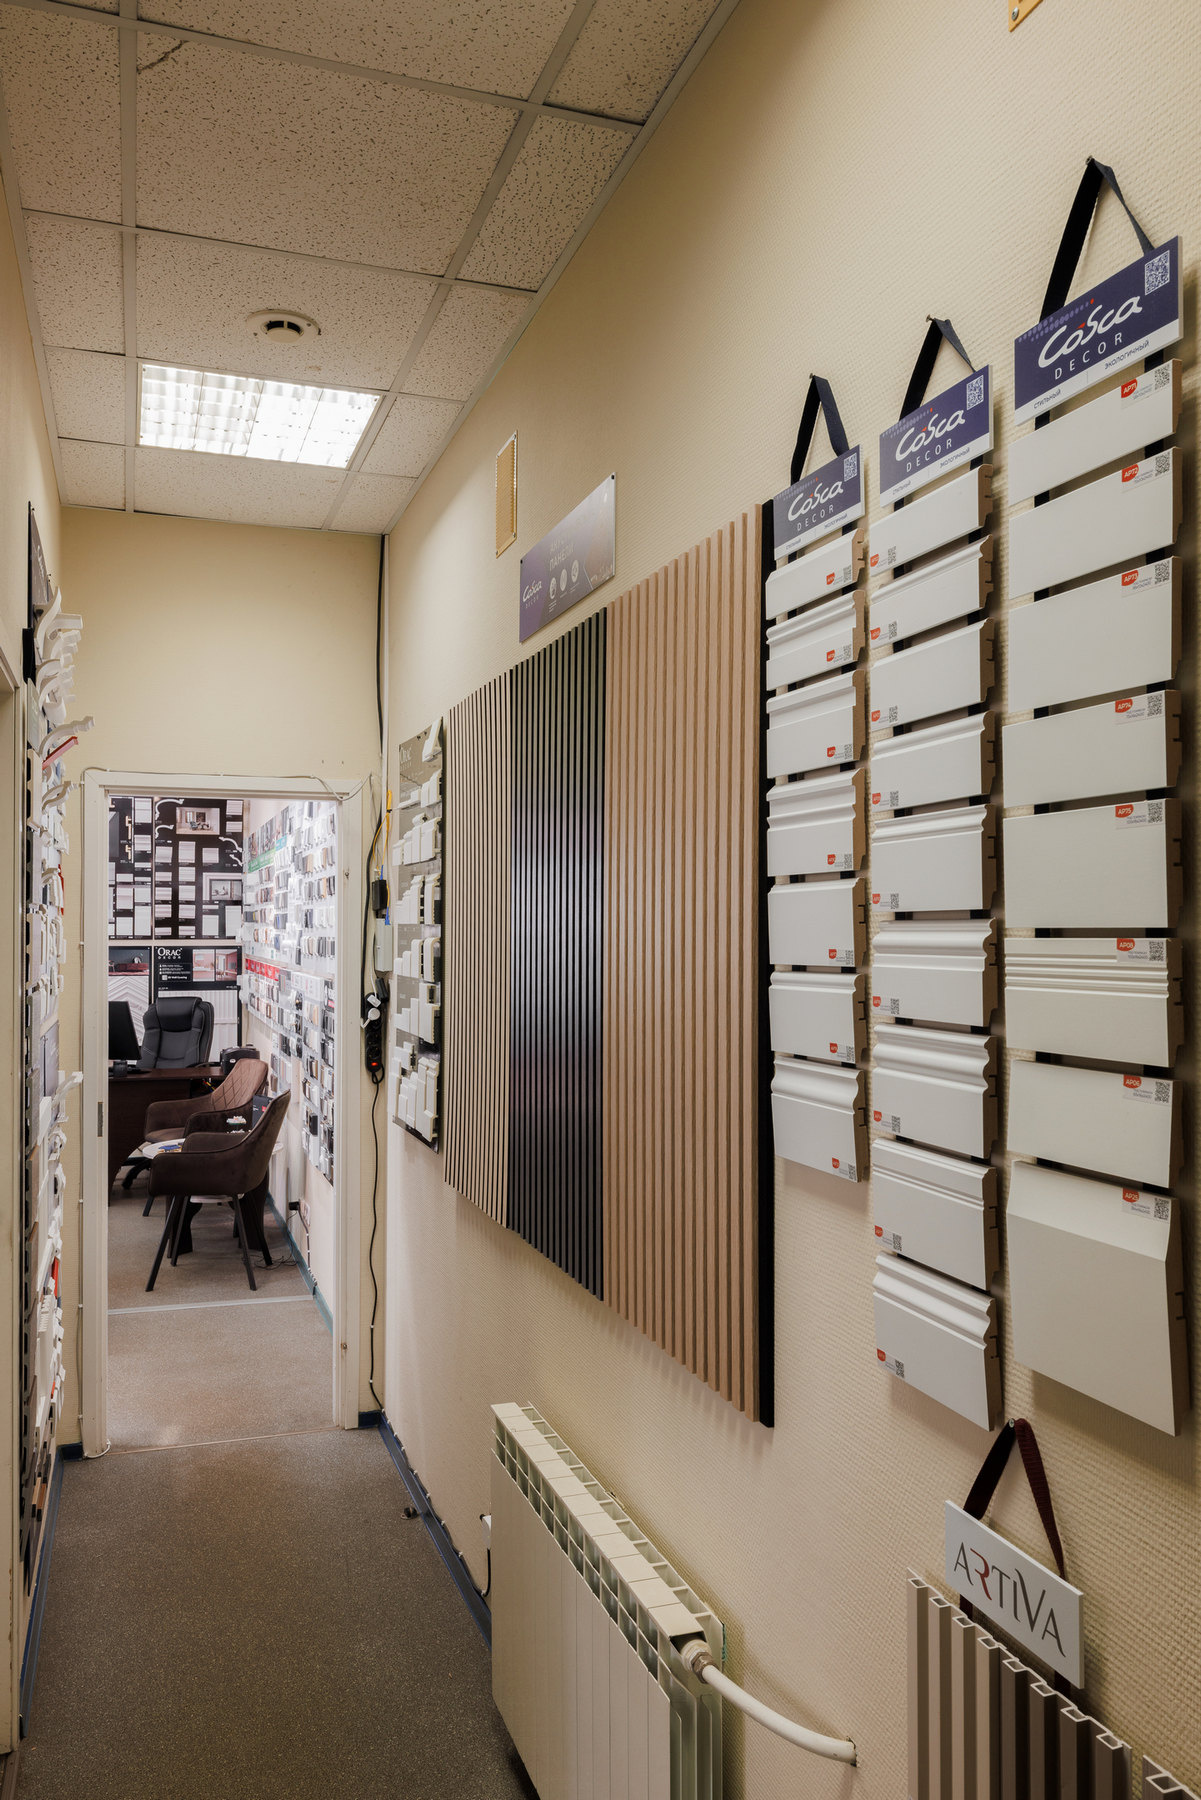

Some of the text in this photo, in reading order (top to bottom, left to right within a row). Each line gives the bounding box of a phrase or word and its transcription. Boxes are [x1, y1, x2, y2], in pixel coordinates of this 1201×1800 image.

[1054, 332, 1123, 380] DECOR
[906, 438, 952, 473] DECOR
[797, 504, 834, 531] DECOR
[954, 1542, 1066, 1658] ARTIVA
